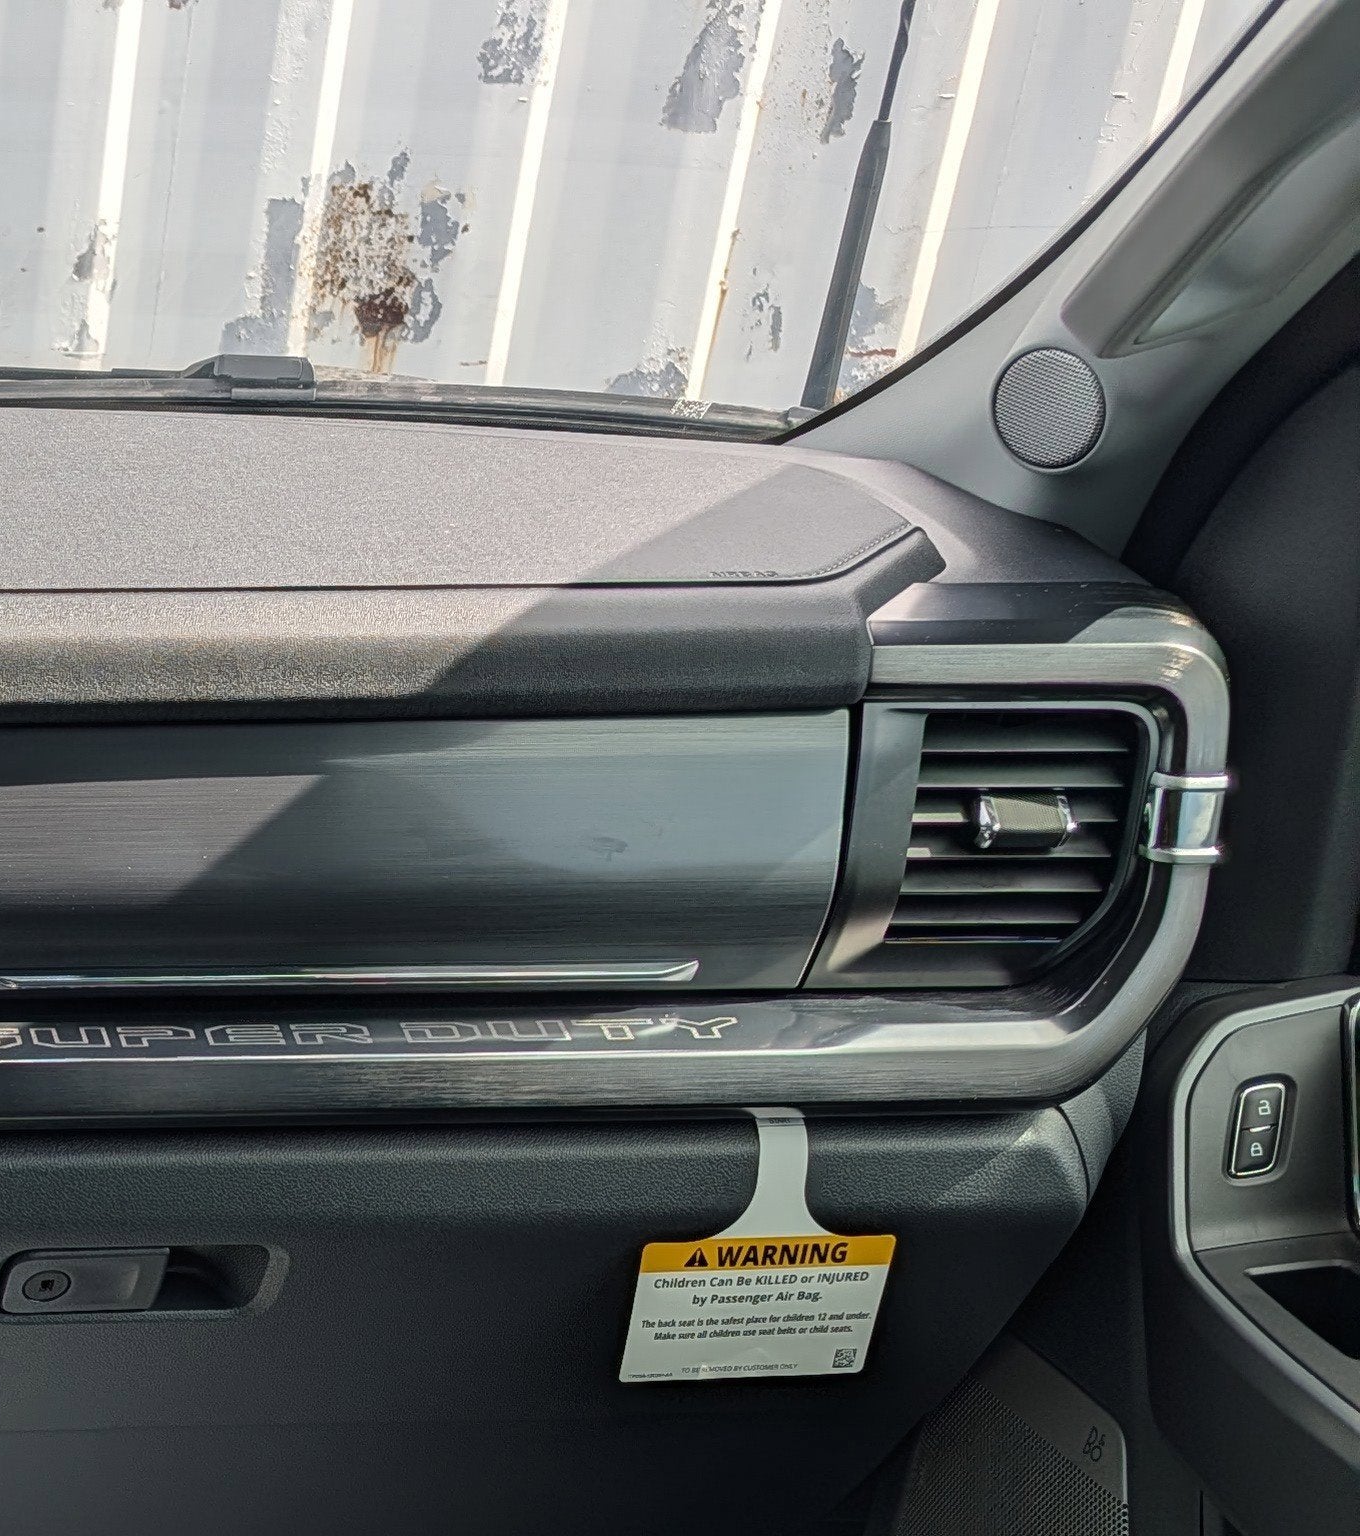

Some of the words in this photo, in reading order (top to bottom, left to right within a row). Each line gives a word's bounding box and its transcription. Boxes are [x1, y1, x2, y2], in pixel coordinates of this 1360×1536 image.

[403, 1016, 739, 1044] DUTY
[717, 1242, 848, 1267] WARNING
[654, 1276, 706, 1289] Children
[709, 1277, 733, 1288] Can
[736, 1276, 752, 1287] Be
[755, 1274, 798, 1286] KILLED
[800, 1275, 814, 1284] or
[816, 1271, 870, 1284] INJURED
[692, 1294, 708, 1307] by
[710, 1293, 774, 1305] Passenger
[776, 1291, 794, 1301] Air
[797, 1290, 823, 1303] Bag.
[642, 1320, 656, 1329] The
[678, 1318, 695, 1327] seat
[697, 1317, 703, 1326] is
[706, 1317, 719, 1326] the
[721, 1316, 744, 1325] safest
[746, 1315, 767, 1327] place
[769, 1314, 781, 1324] for
[783, 1313, 815, 1322] children
[817, 1312, 826, 1321] 12
[828, 1312, 844, 1321] and
[846, 1310, 871, 1320] under.
[654, 1331, 677, 1340] Make
[678, 1331, 695, 1339] sure
[697, 1330, 707, 1339] all
[709, 1328, 741, 1338] children
[758, 1327, 775, 1336] seat
[798, 1326, 807, 1334] or
[809, 1325, 828, 1334] child
[830, 1324, 853, 1333] seats.
[743, 1364, 779, 1372] CUSTOMER
